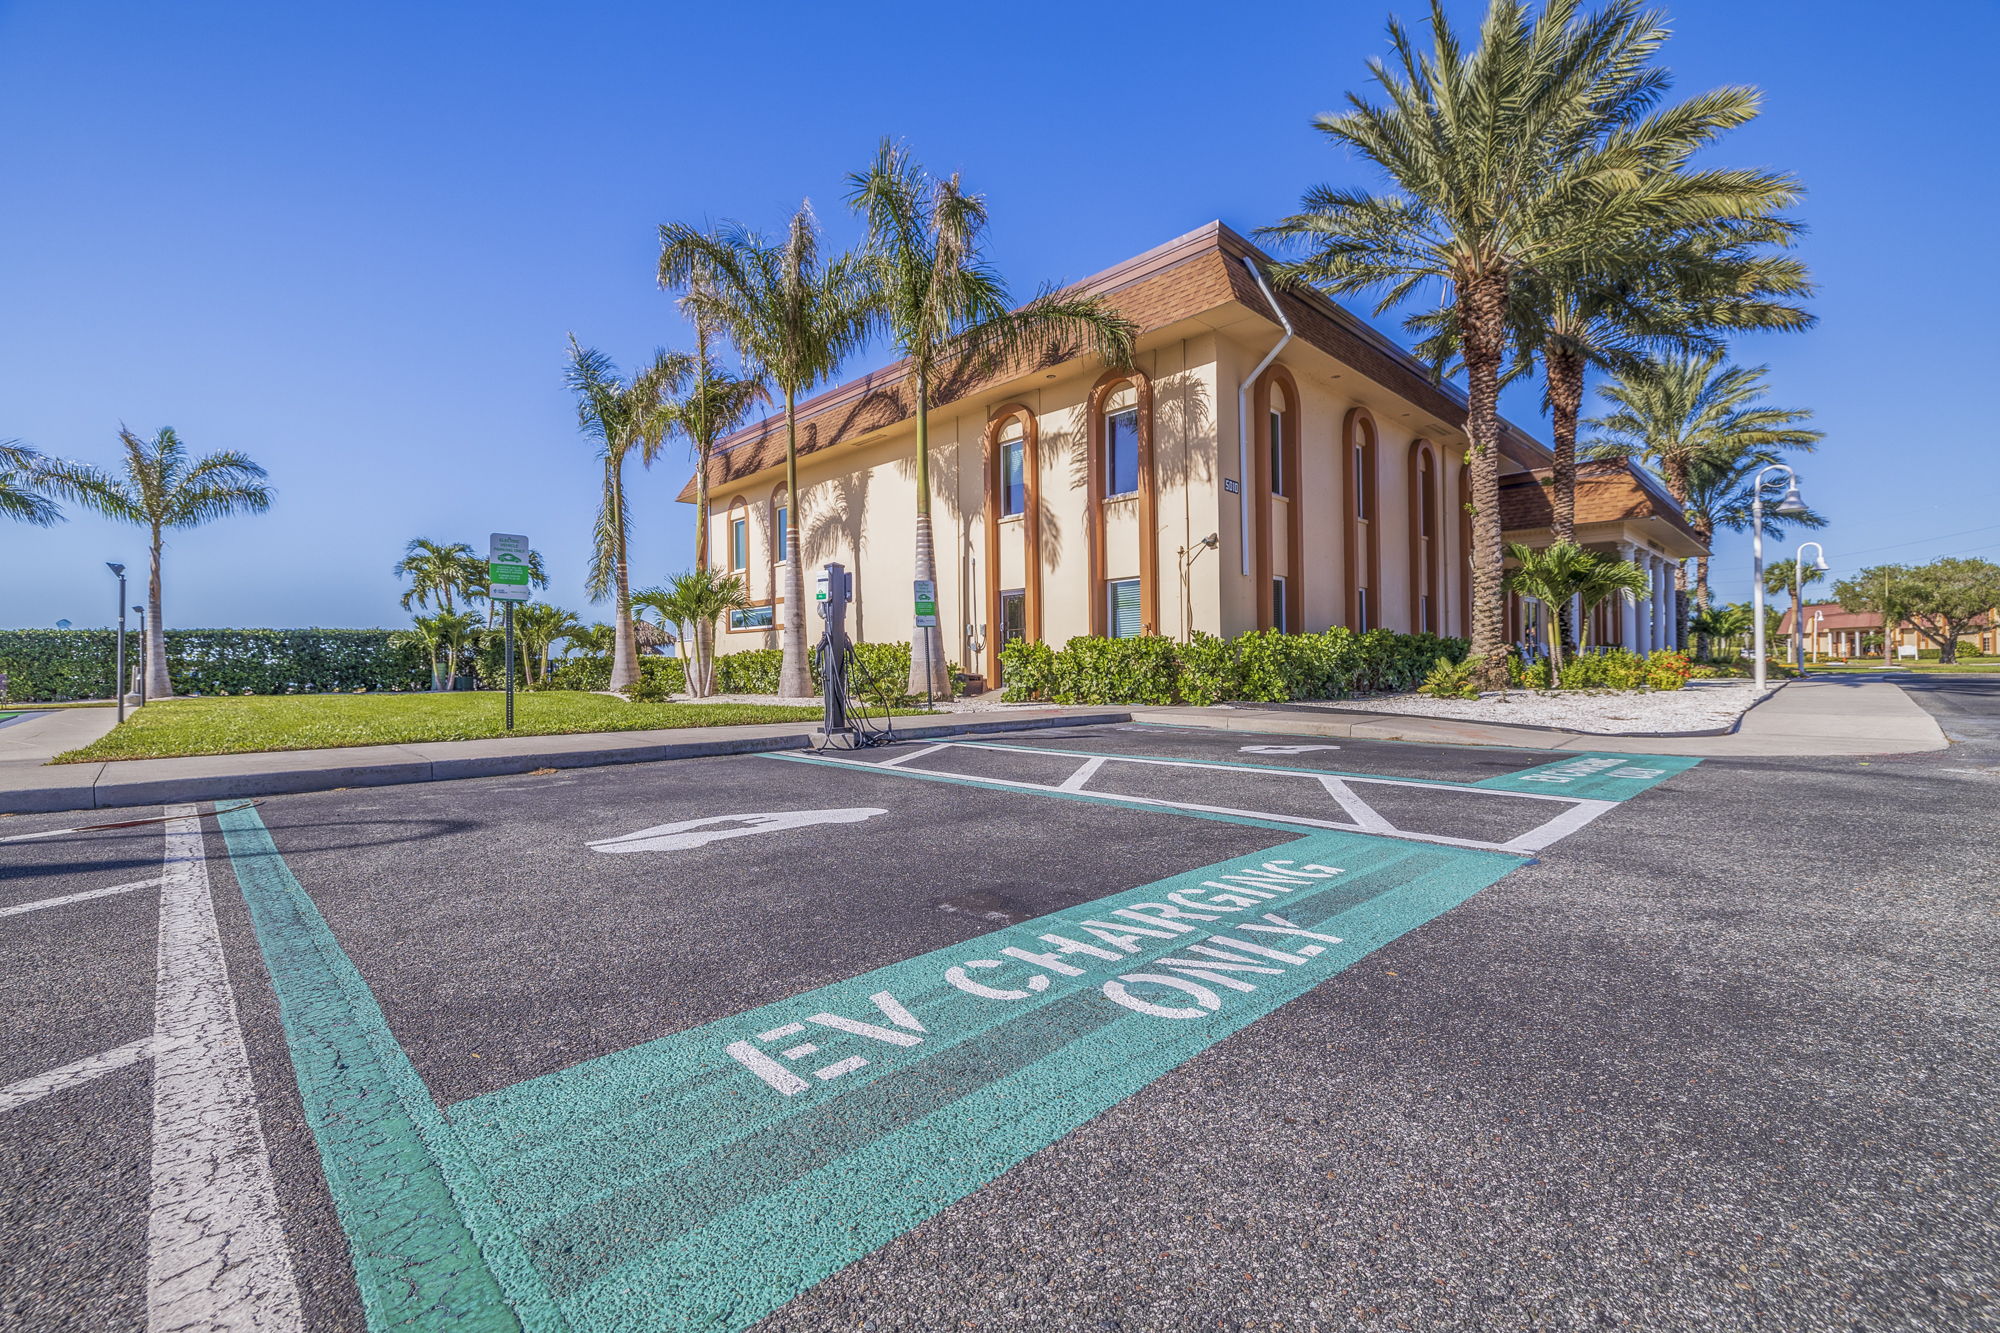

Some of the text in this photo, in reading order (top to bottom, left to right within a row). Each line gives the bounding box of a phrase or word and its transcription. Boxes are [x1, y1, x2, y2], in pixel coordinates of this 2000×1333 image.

[725, 860, 1346, 1096] EV CHARGING
[1103, 913, 1343, 1019] ONLY
